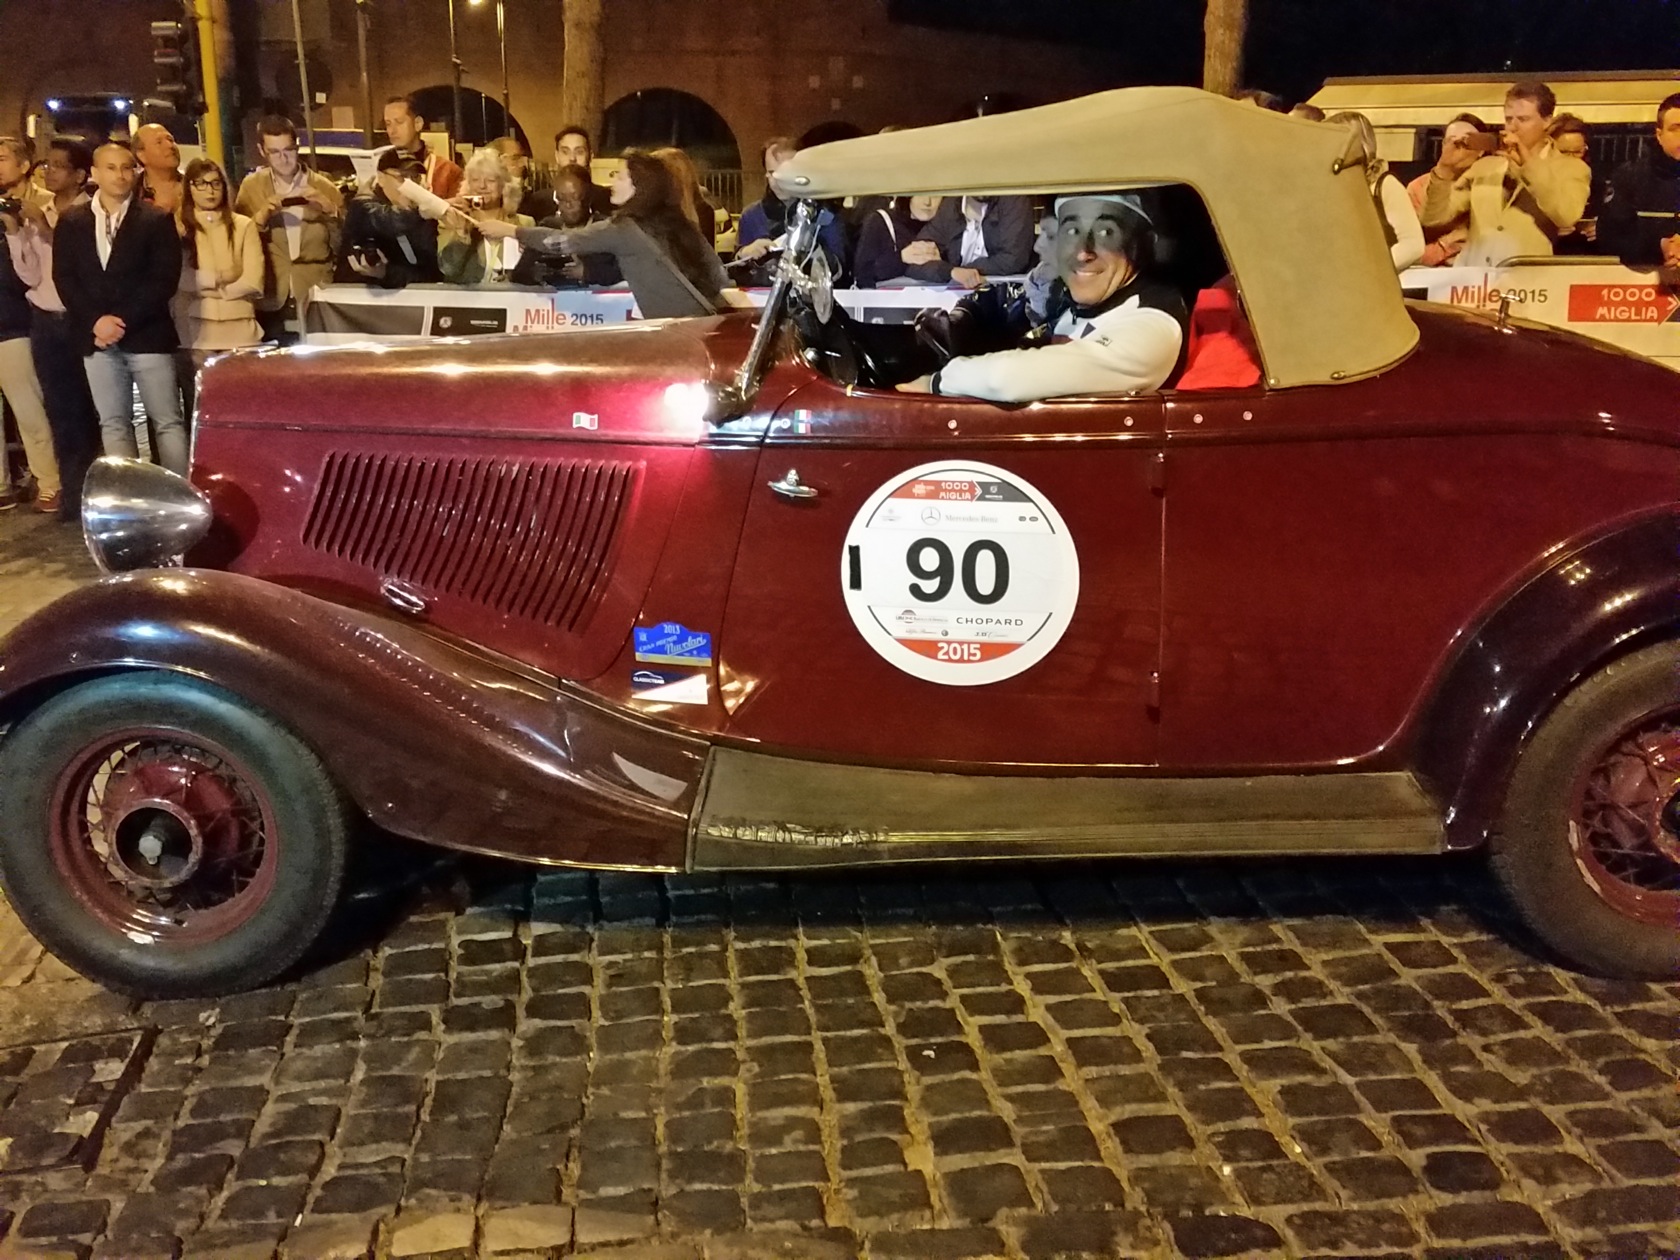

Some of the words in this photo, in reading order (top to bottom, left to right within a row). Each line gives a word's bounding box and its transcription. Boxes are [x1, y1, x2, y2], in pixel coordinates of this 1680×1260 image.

[1450, 273, 1501, 304] Mille
[1601, 287, 1656, 301] 1000
[525, 298, 567, 326] Mille
[571, 313, 604, 326] 2015
[1595, 306, 1659, 320] MIGLIA
[941, 482, 970, 490] 1000
[939, 491, 972, 500] MIGLIA
[906, 537, 1010, 605] 90
[956, 616, 1024, 627] CHOPARD
[937, 642, 982, 661] 2015
